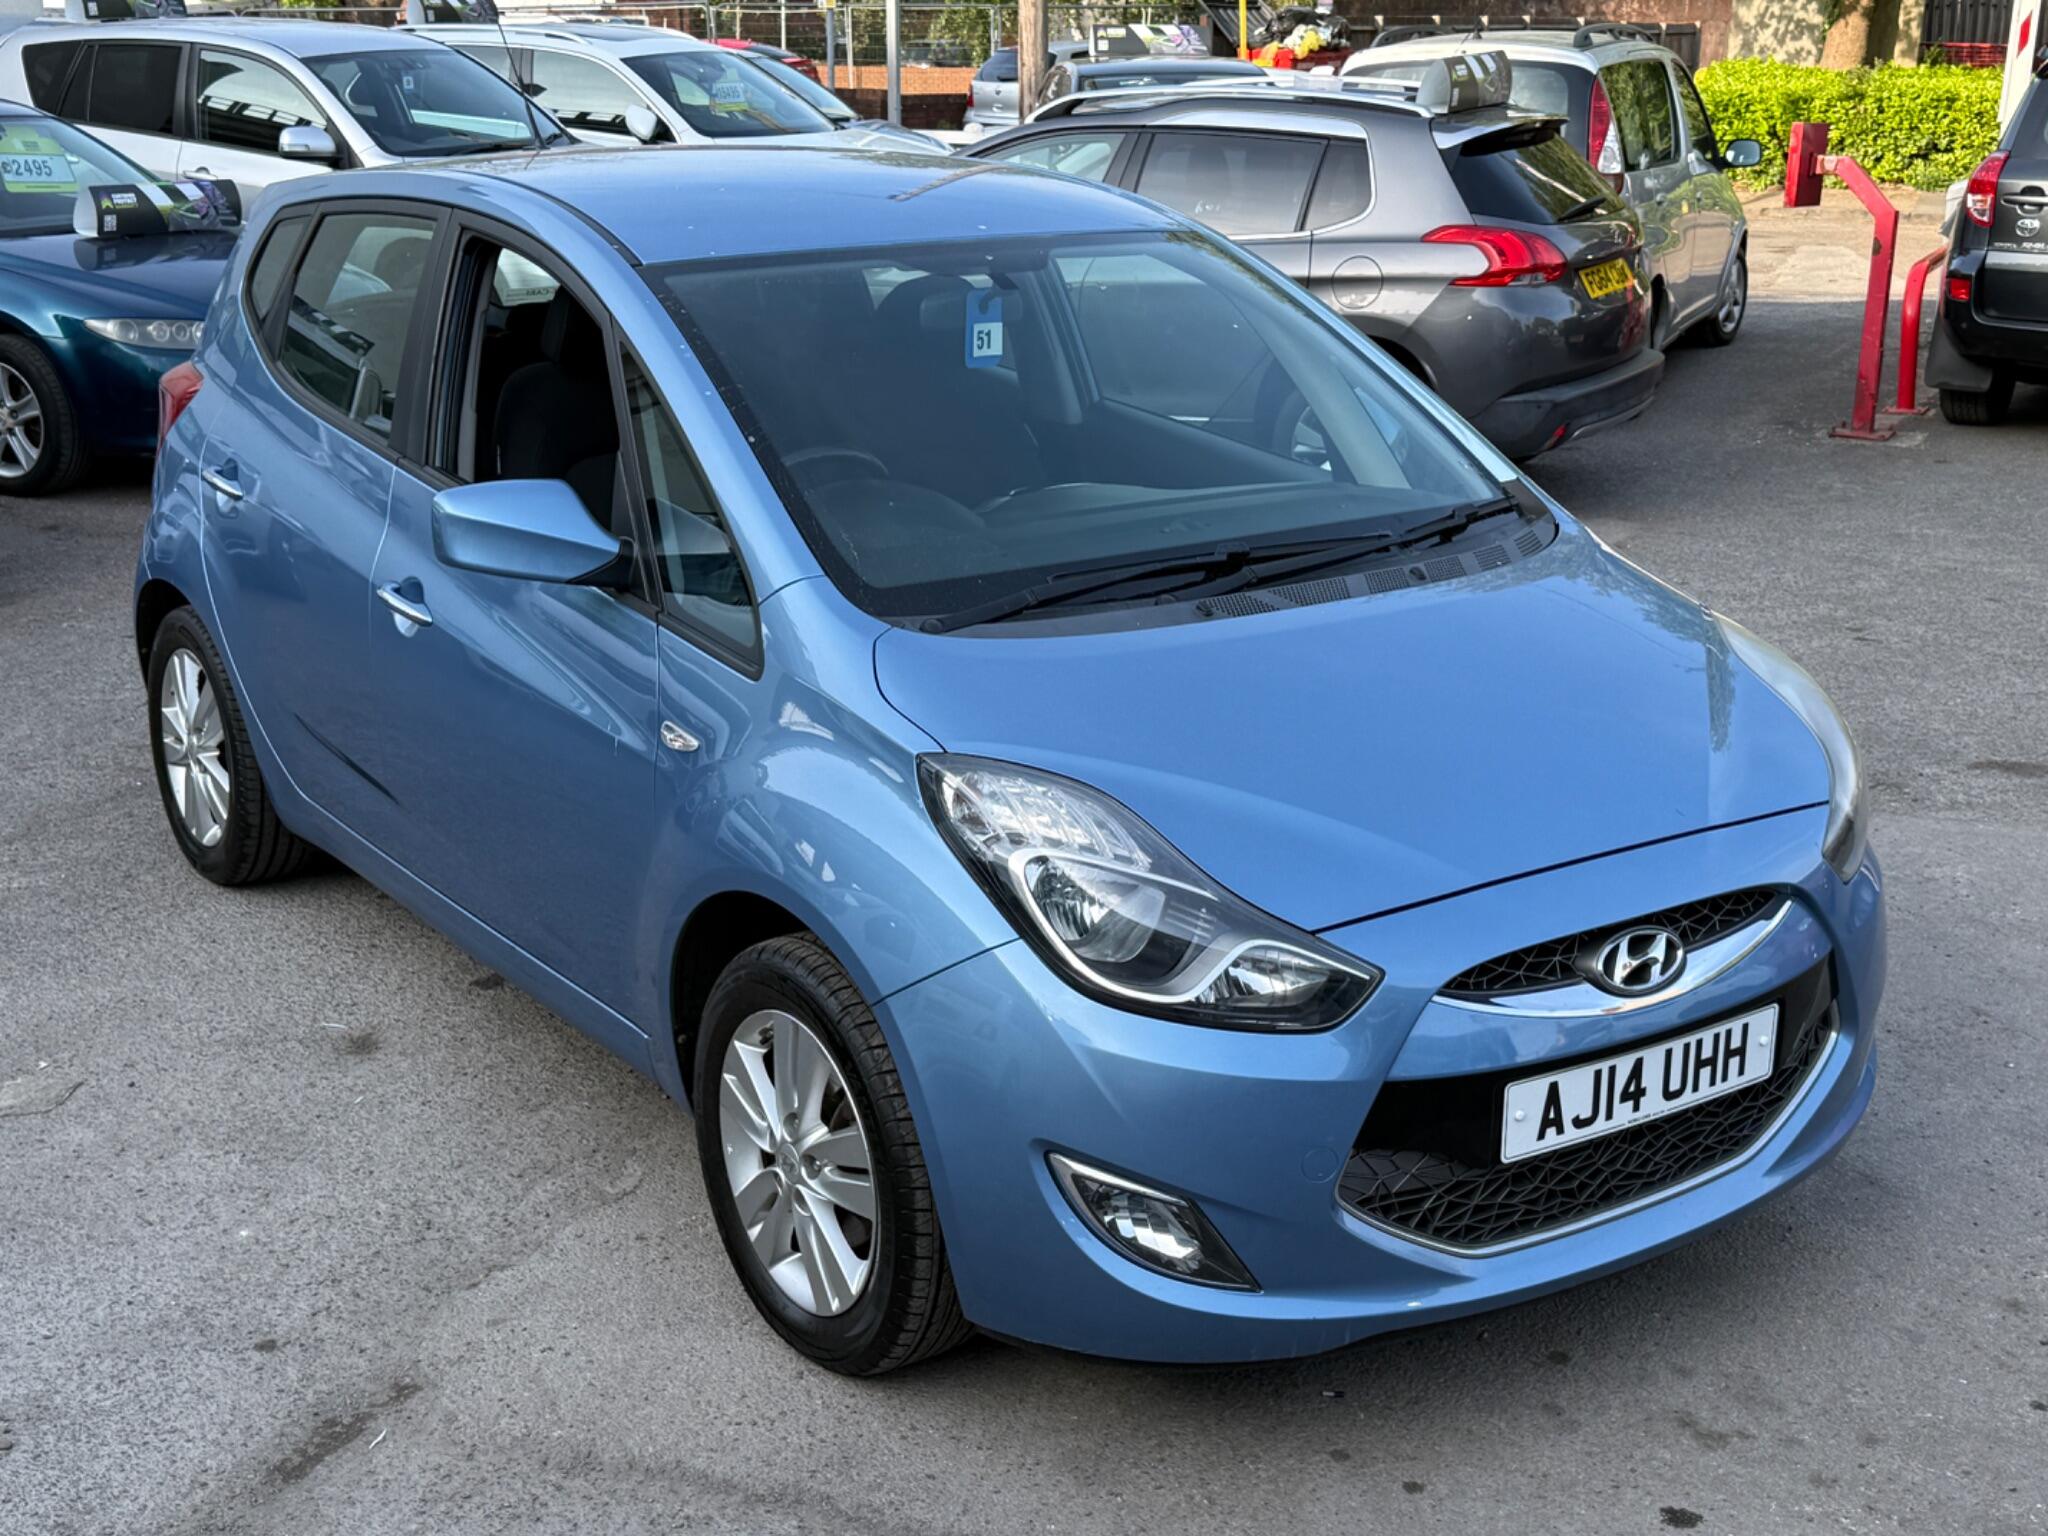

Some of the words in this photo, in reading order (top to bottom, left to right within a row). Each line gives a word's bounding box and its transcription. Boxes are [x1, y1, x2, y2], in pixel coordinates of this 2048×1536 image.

[976, 328, 992, 351] 51
[1536, 1056, 1647, 1142] AJ14
[1662, 1022, 1750, 1102] UHH
